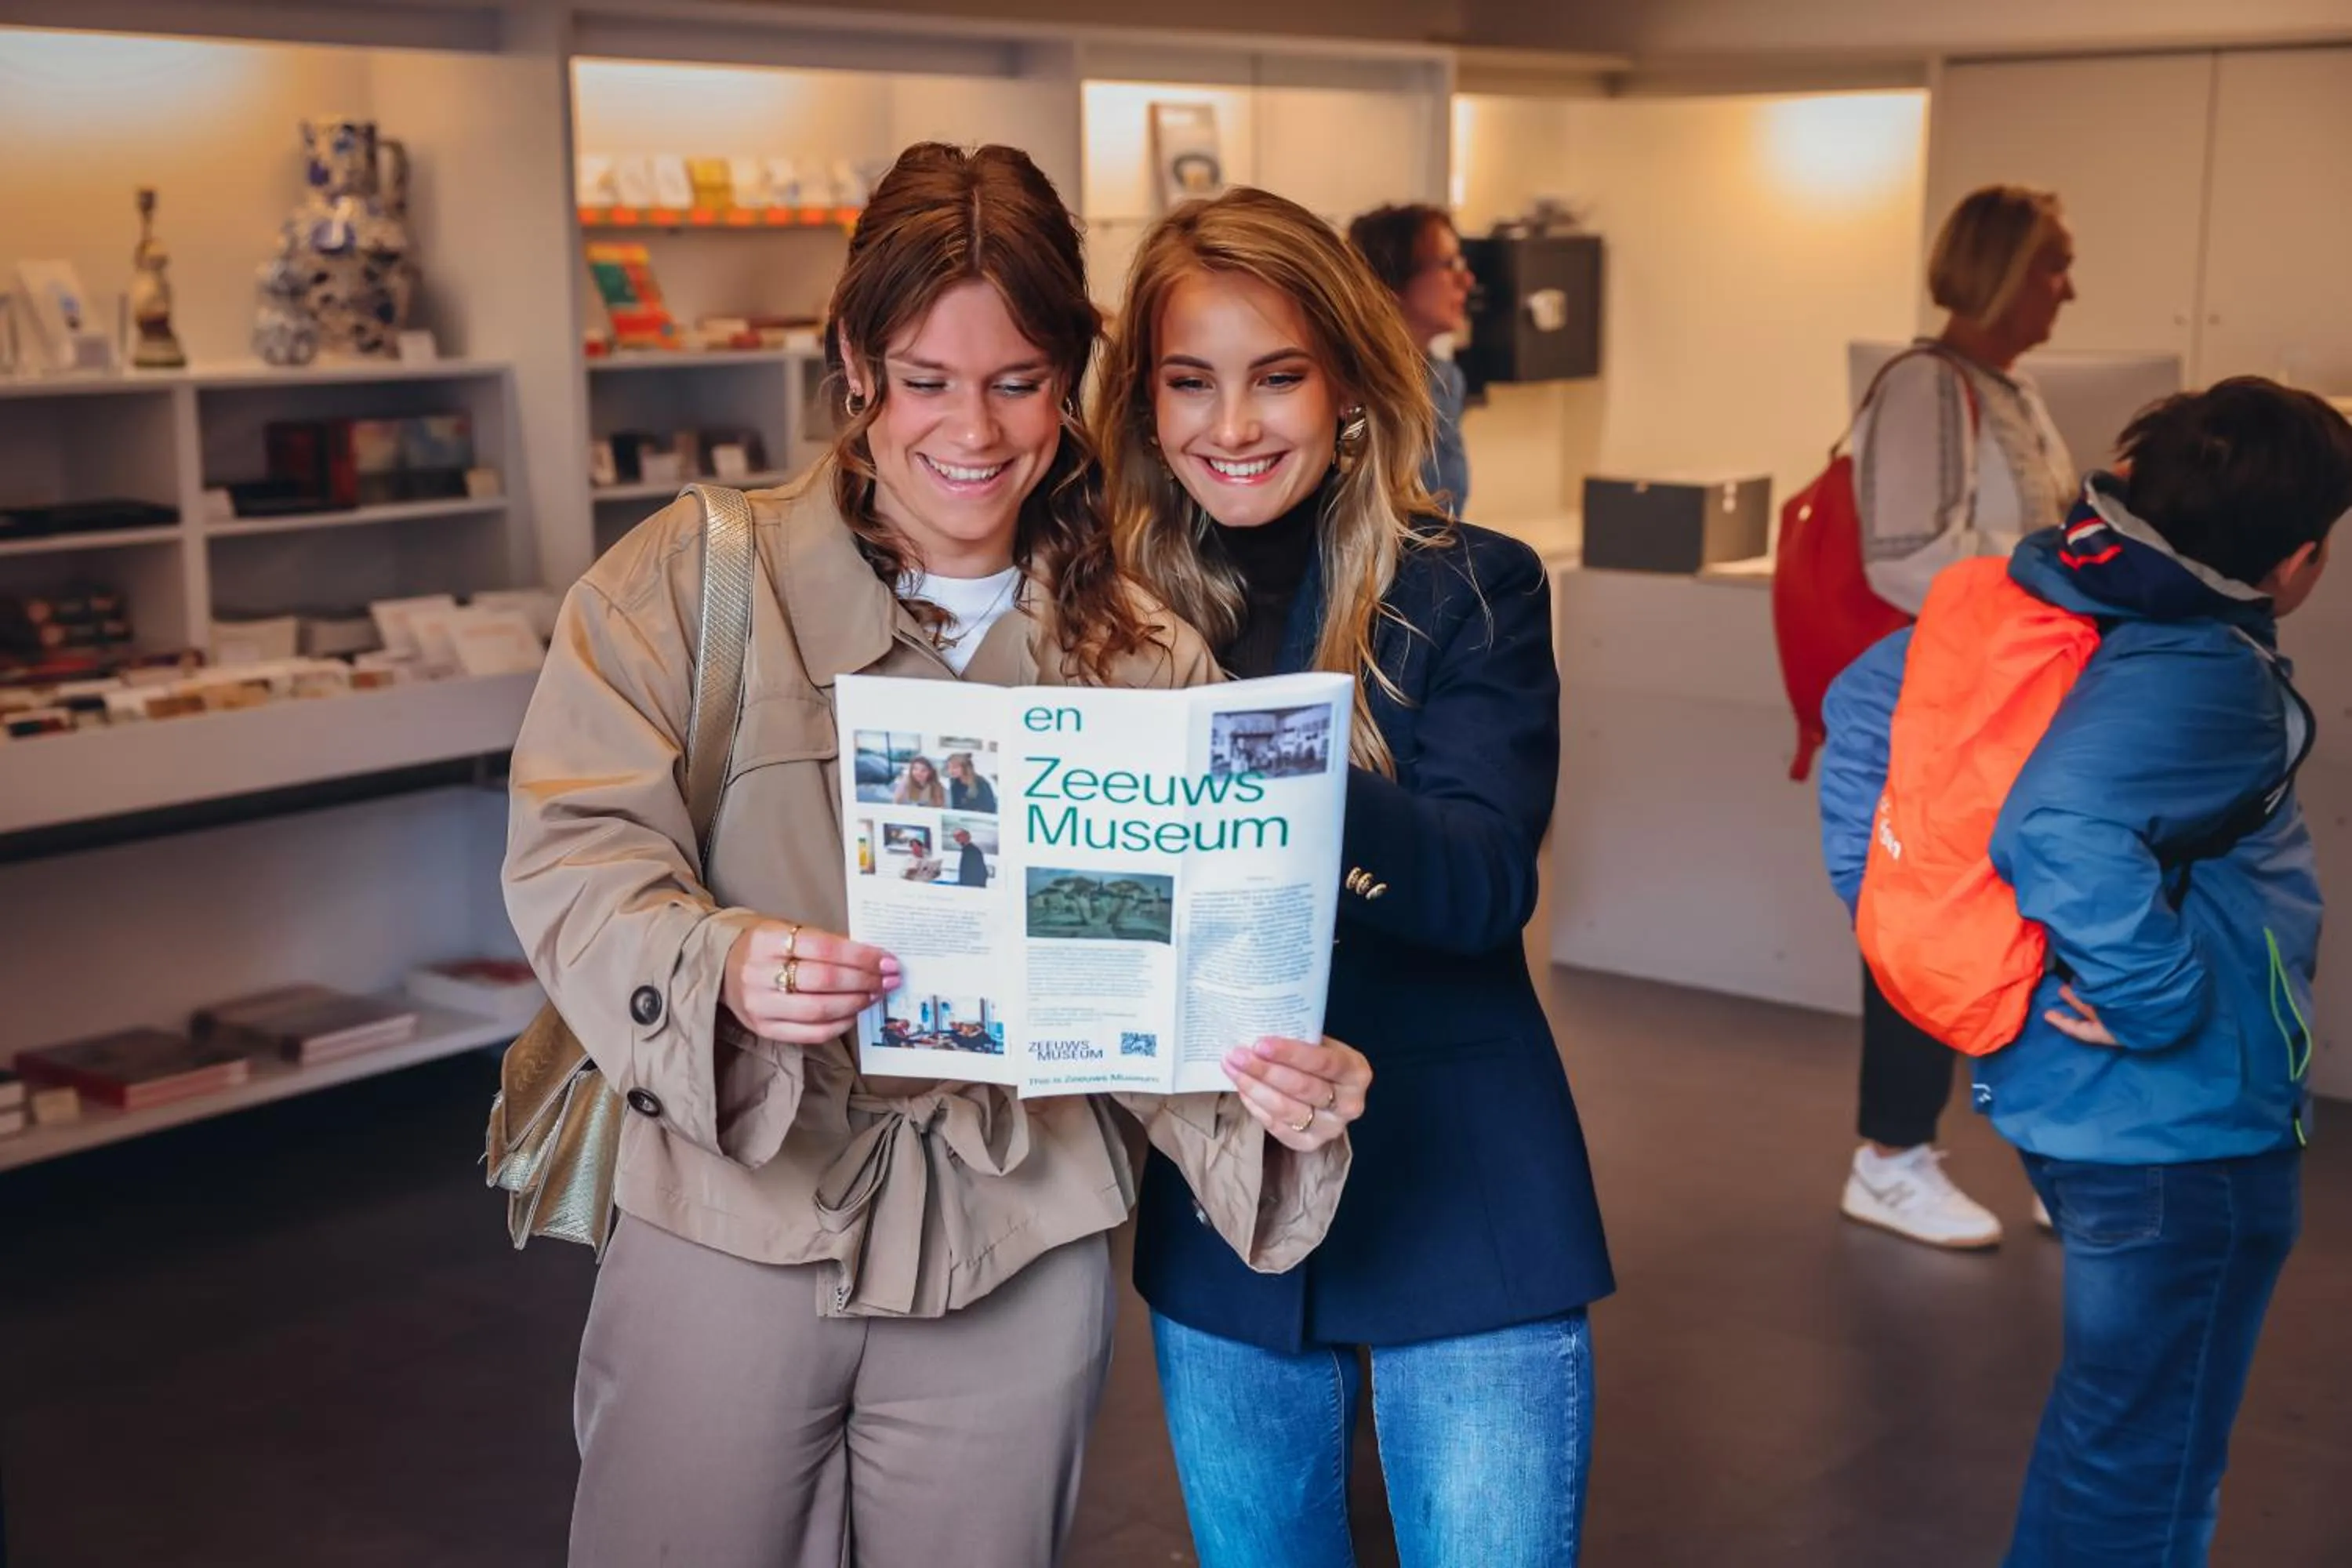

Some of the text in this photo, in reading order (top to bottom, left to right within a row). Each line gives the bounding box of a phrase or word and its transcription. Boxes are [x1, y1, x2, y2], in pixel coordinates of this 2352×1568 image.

[1024, 706, 1082, 732] en
[1024, 757, 1265, 806] Zeeuws
[1028, 804, 1288, 854] Museum
[1028, 1040, 1091, 1052] ZEEUWS
[1036, 1049, 1103, 1061] MUSEUM
